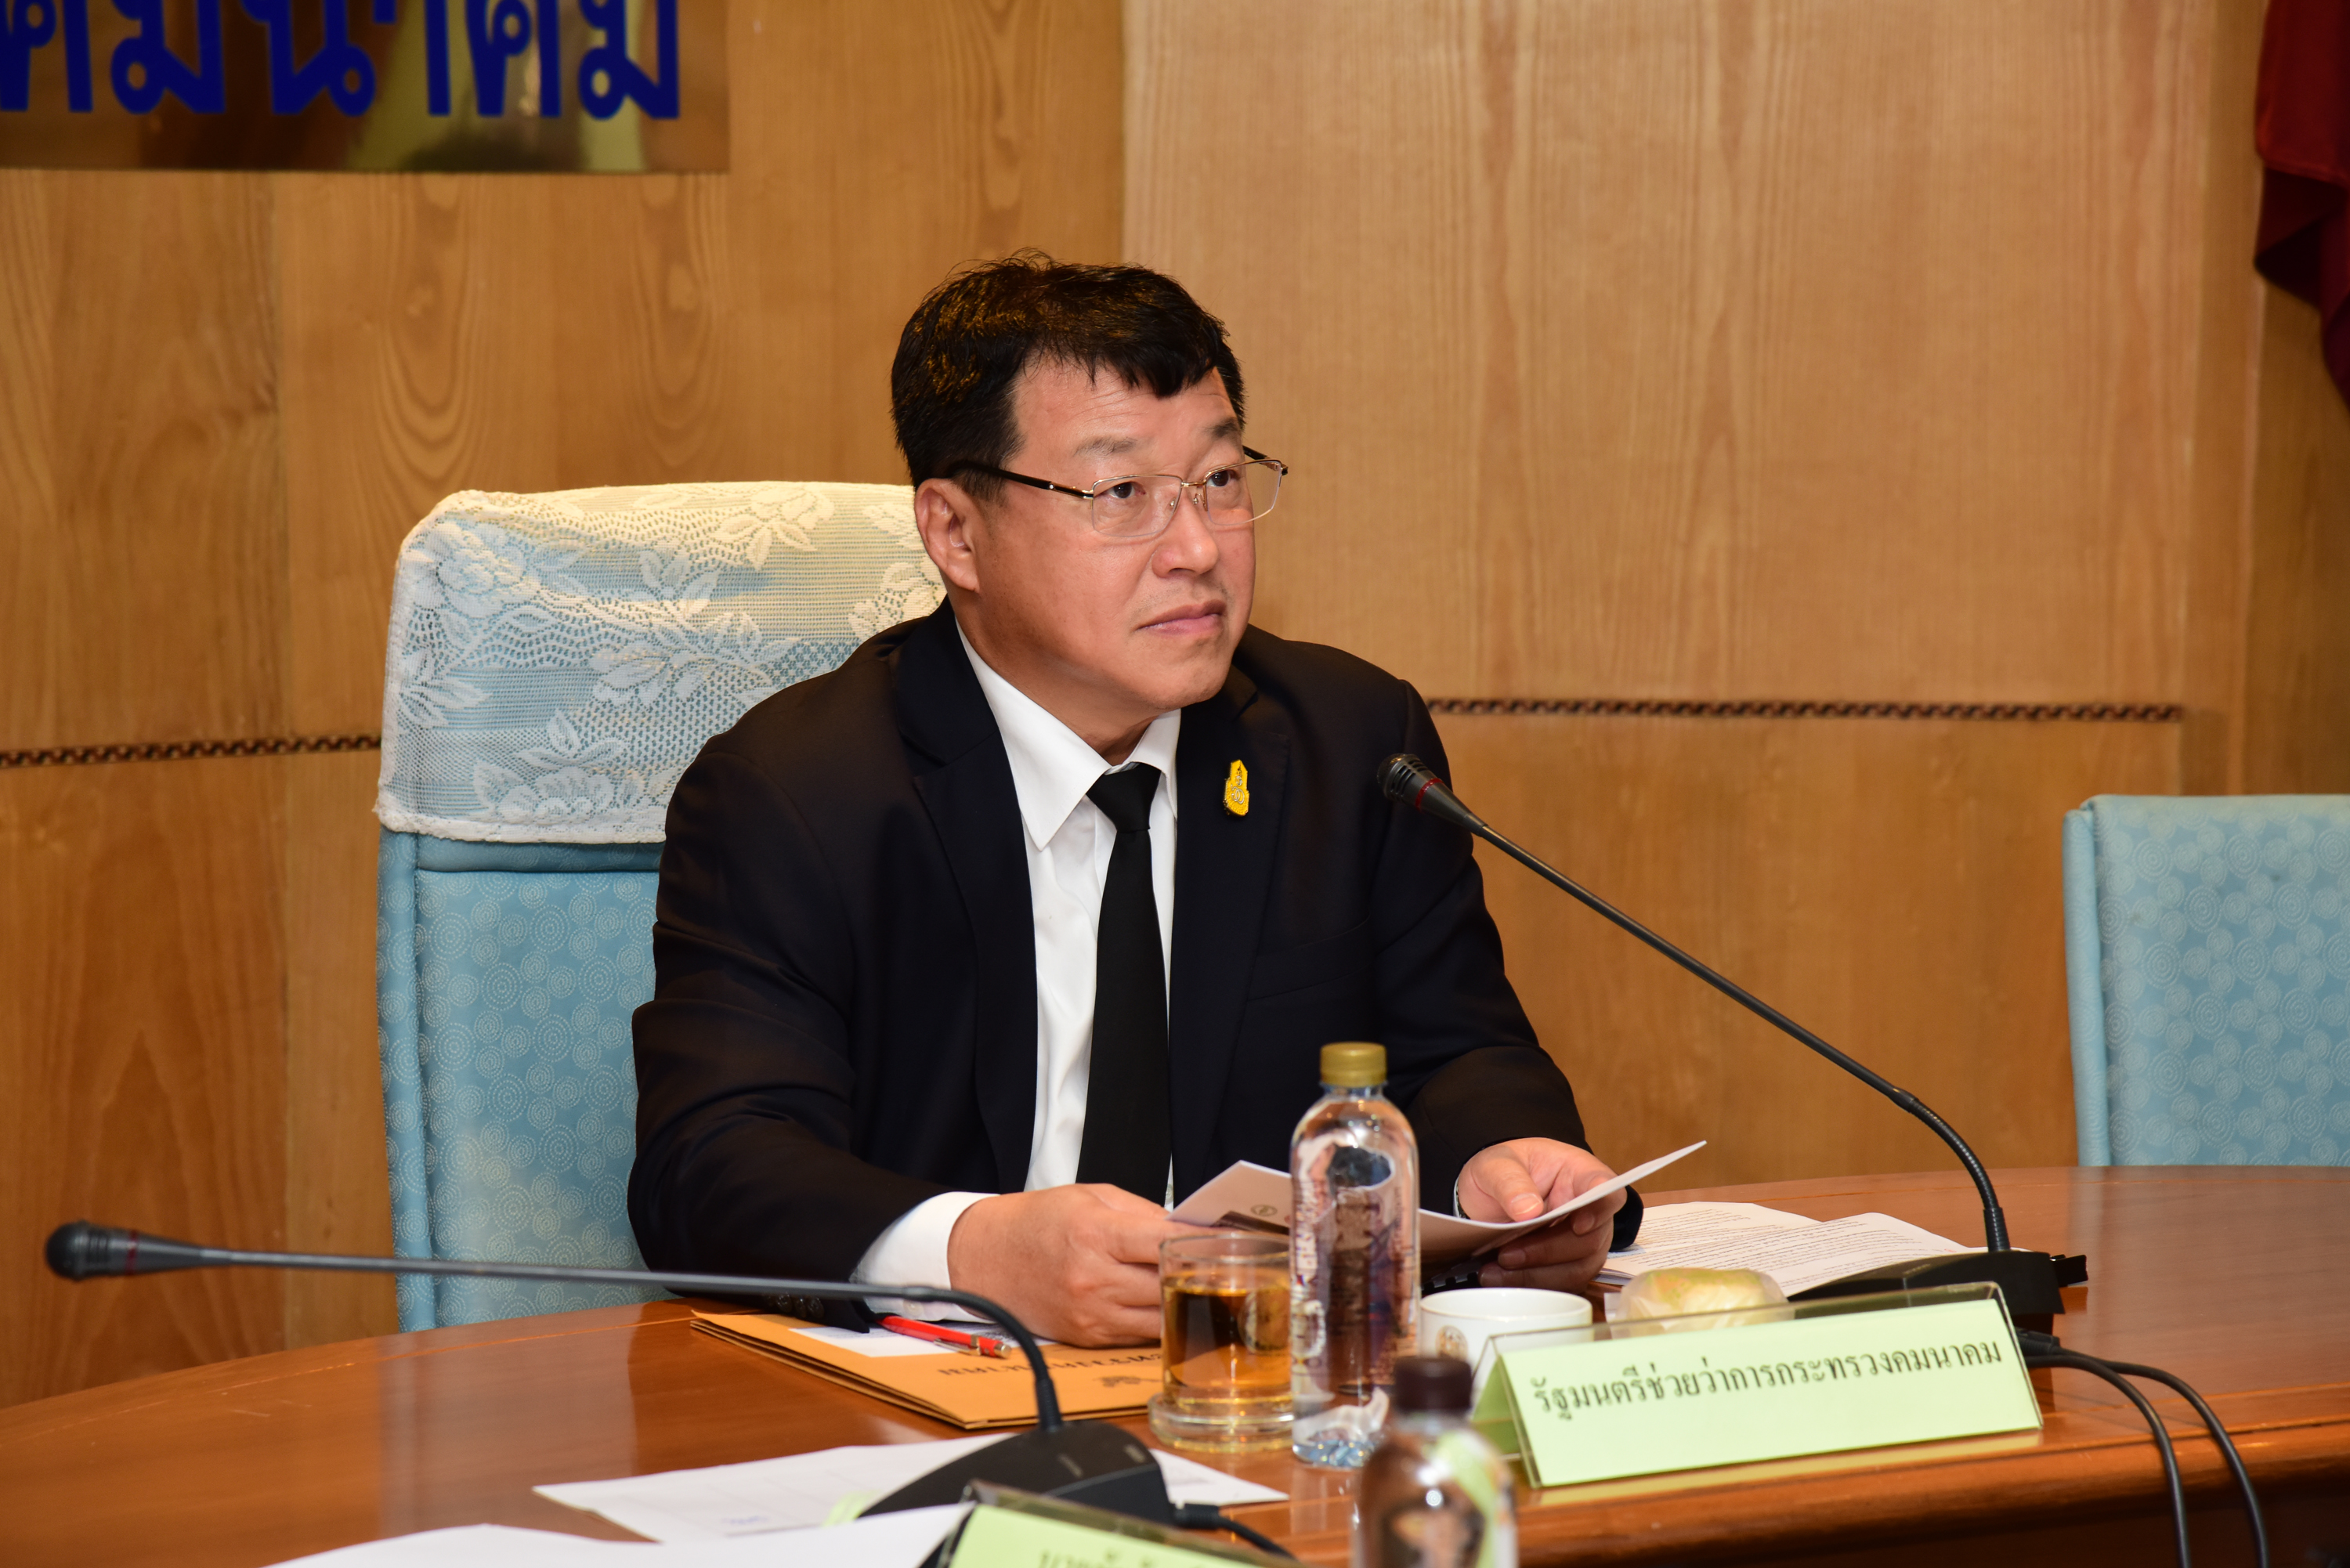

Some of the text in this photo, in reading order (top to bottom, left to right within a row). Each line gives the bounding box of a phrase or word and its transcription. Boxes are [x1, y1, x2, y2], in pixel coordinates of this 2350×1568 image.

[1530, 1340, 2003, 1420] รัฐมนตรีช่วยว่าการกระทรวงคมนาคม
